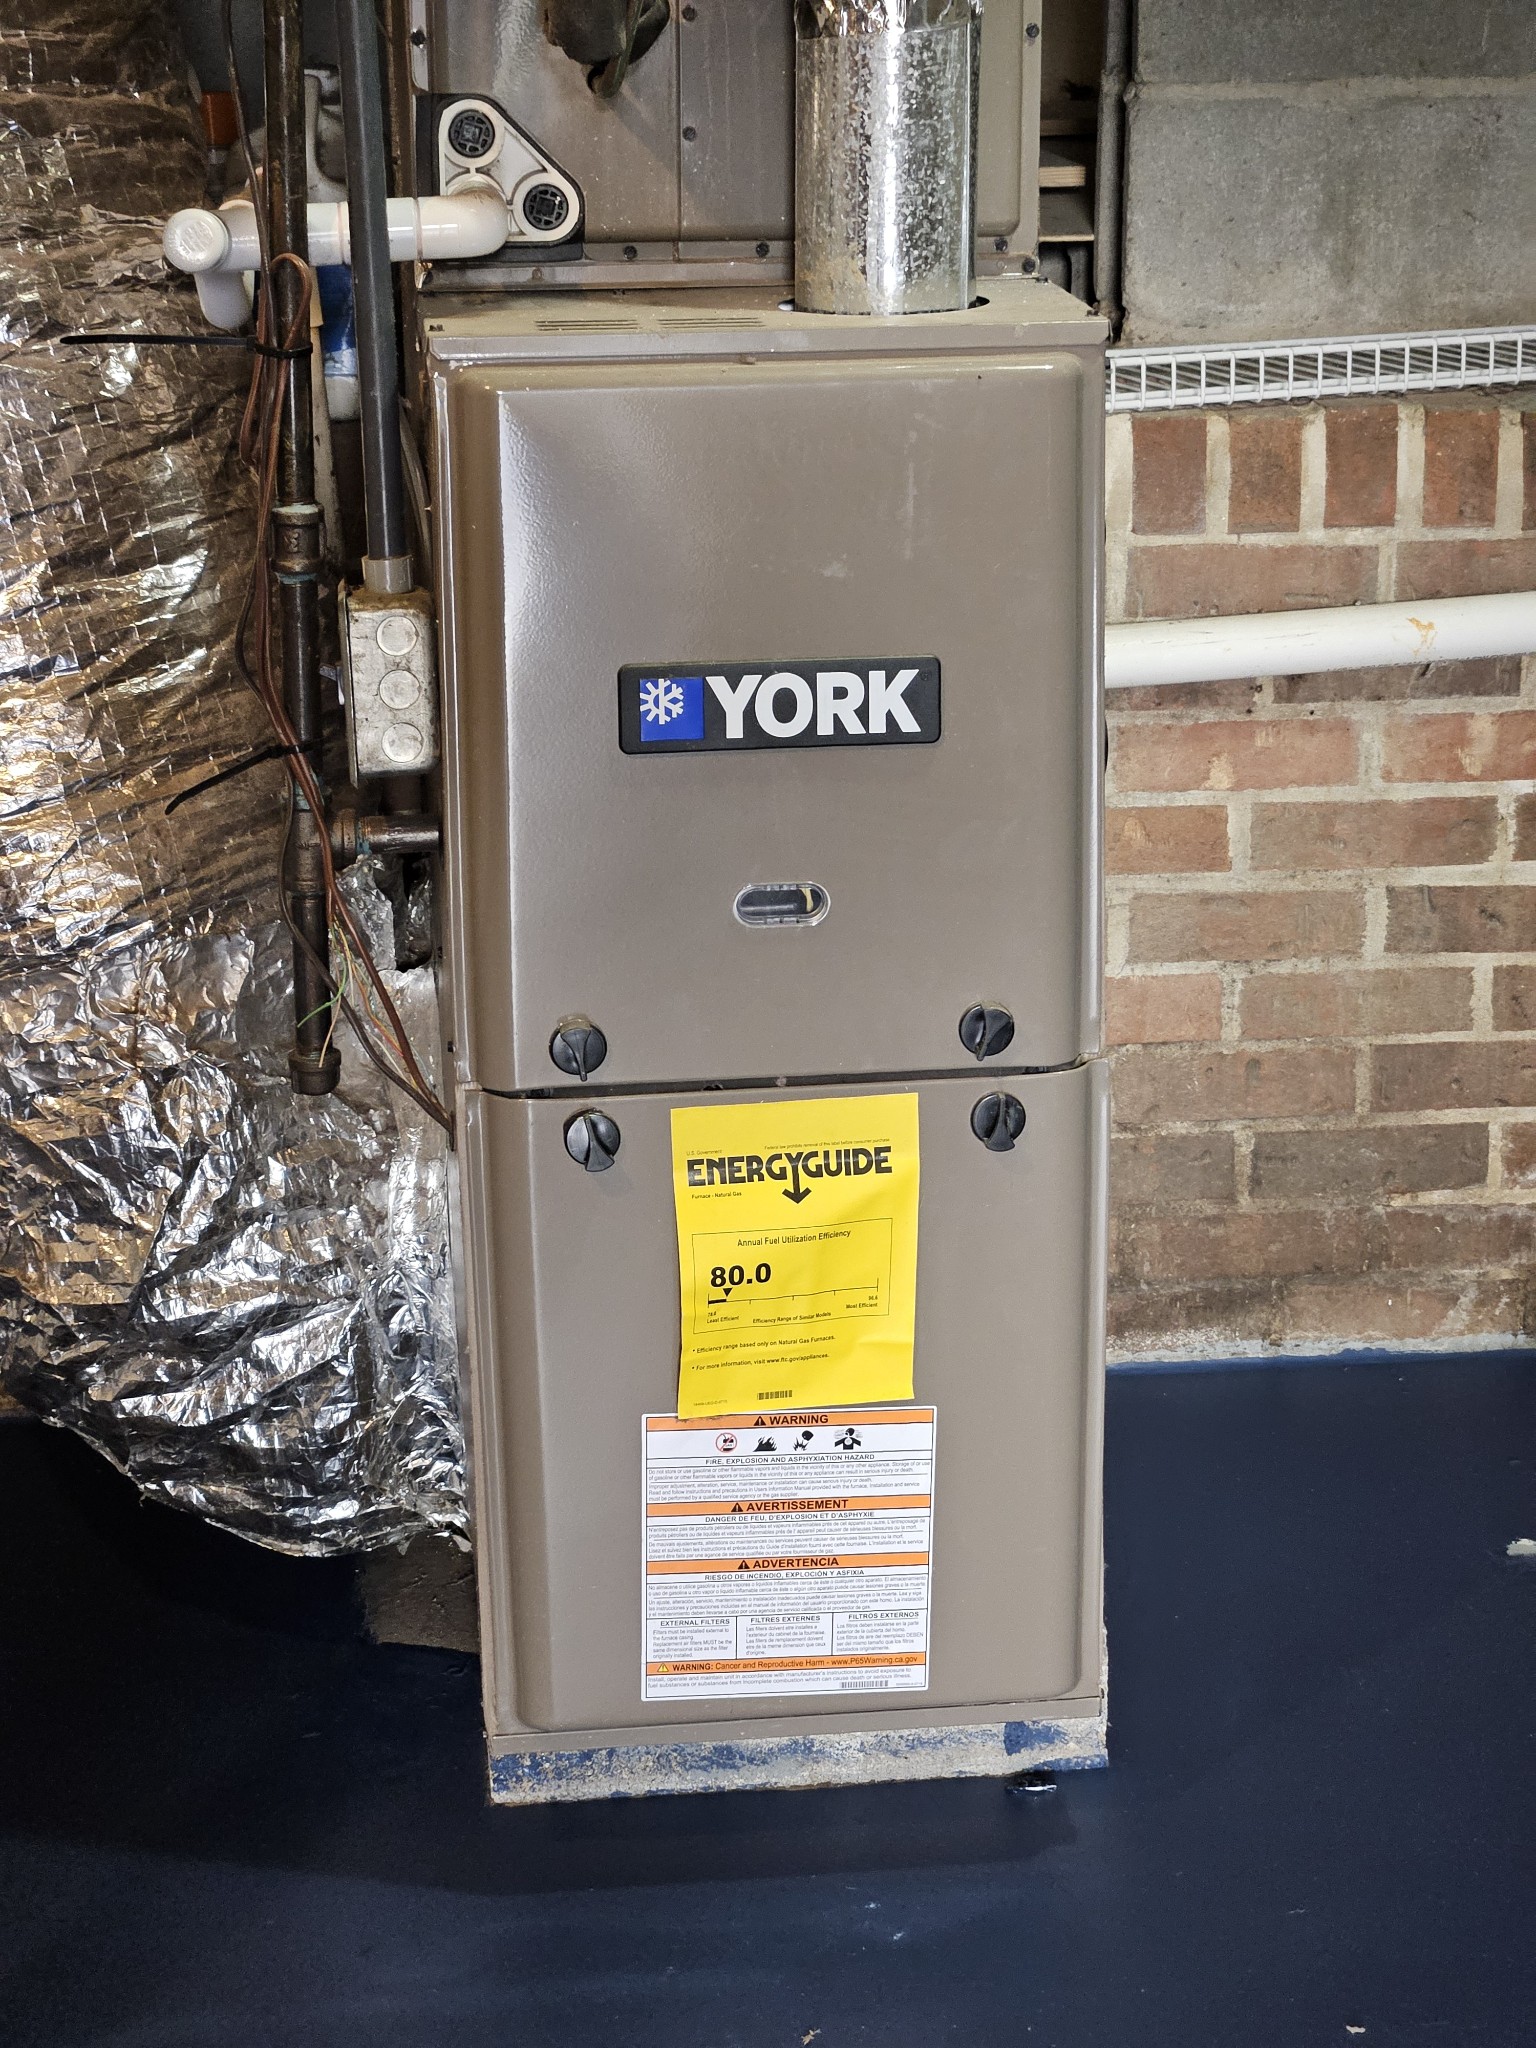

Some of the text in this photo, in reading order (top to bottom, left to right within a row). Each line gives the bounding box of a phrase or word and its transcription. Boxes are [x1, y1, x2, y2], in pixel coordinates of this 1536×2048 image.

[706, 669, 920, 739] YORK
[687, 1146, 892, 1187] ENERGYGUIDE
[737, 1229, 851, 1246] Annual Fuel Utilization Efficiency
[710, 1262, 771, 1287] 80.0
[753, 1316, 775, 1325] Efficiency
[697, 1344, 721, 1353] Efficiency
[720, 1359, 752, 1368] information,
[769, 1414, 829, 1425] WARNING
[746, 1499, 848, 1511] AVERTISSEMENT
[753, 1556, 839, 1568] ADVERTENCIA
[673, 1663, 713, 1671] WARNING:
[757, 1659, 803, 1669] Reproductive
[831, 1655, 917, 1667] www.P65Warning.ca.gov
